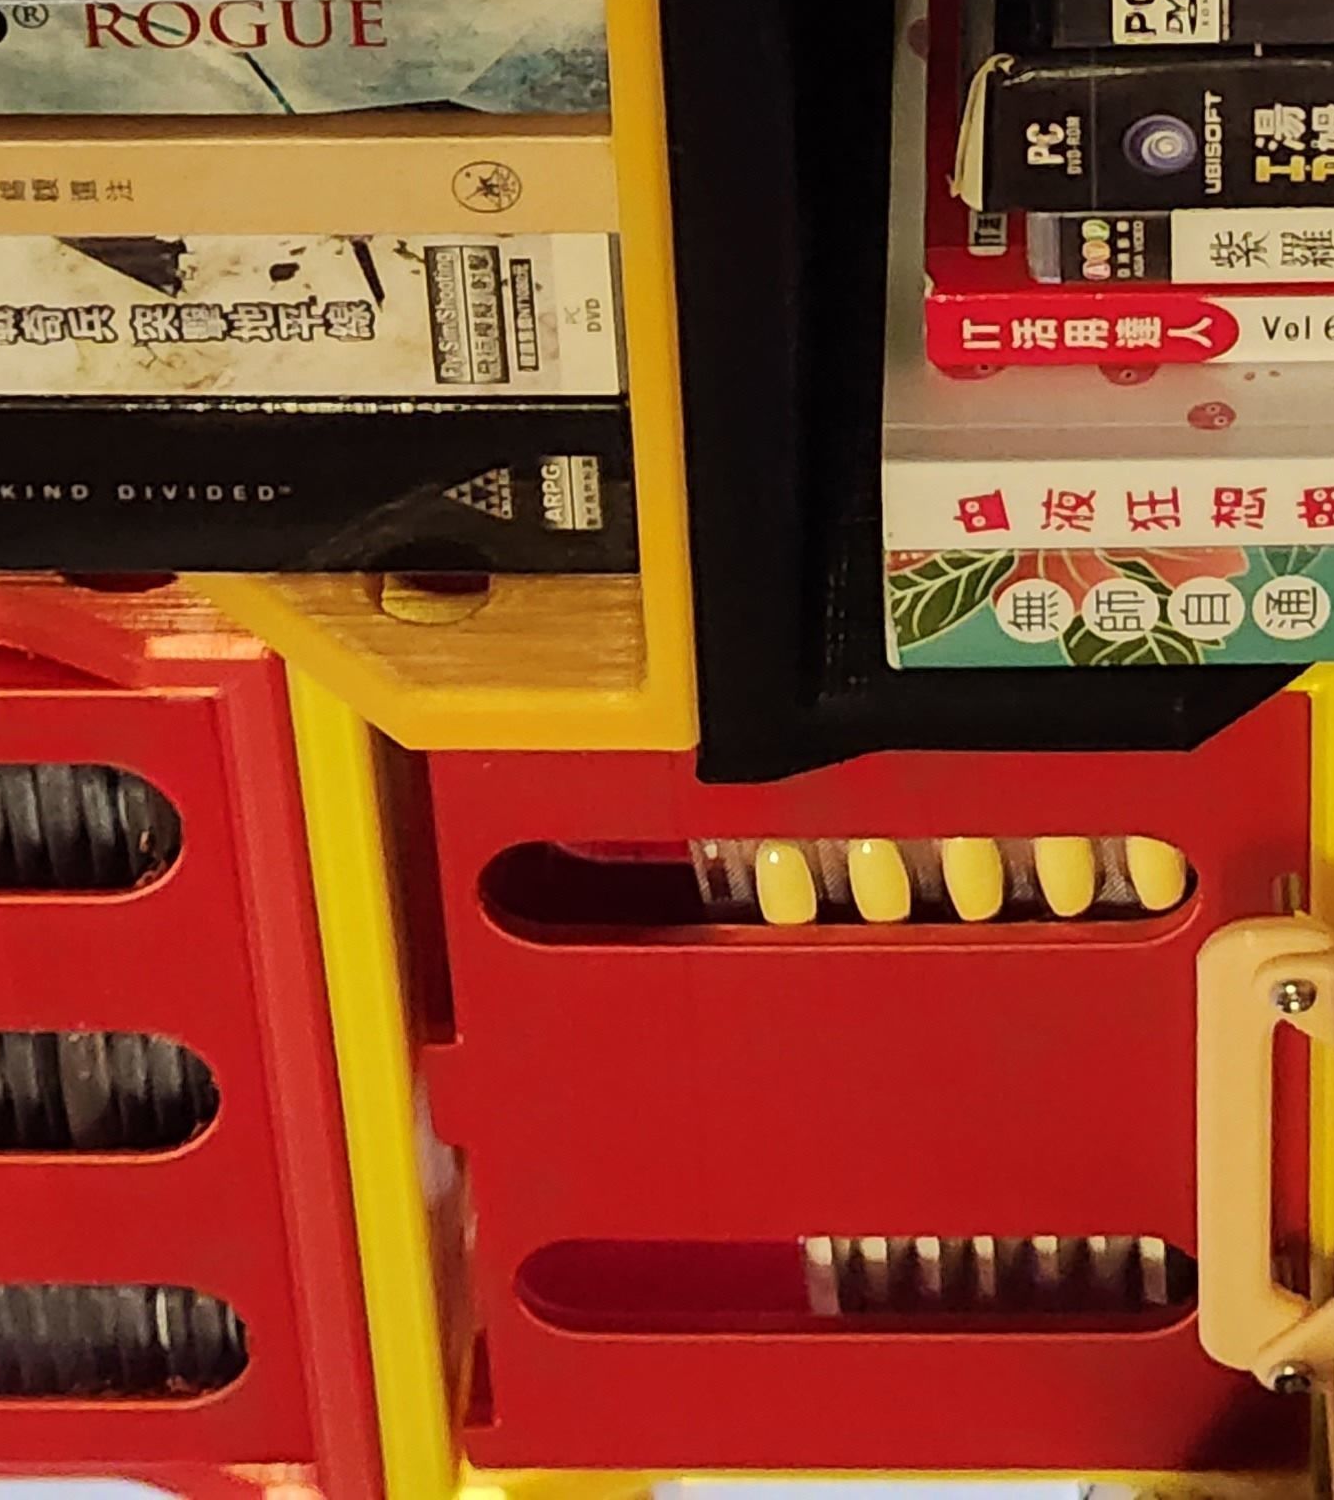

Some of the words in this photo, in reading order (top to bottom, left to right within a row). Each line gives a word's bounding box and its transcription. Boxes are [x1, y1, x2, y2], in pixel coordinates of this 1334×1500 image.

[1026, 122, 1066, 166] PC
[1203, 89, 1223, 195] UBISOFT
[585, 297, 603, 333] DVD
[961, 315, 1219, 350] IT活用達人
[1261, 315, 1311, 341] Vol
[540, 463, 565, 524] ARPG
[1008, 585, 1319, 633] 無師自通
